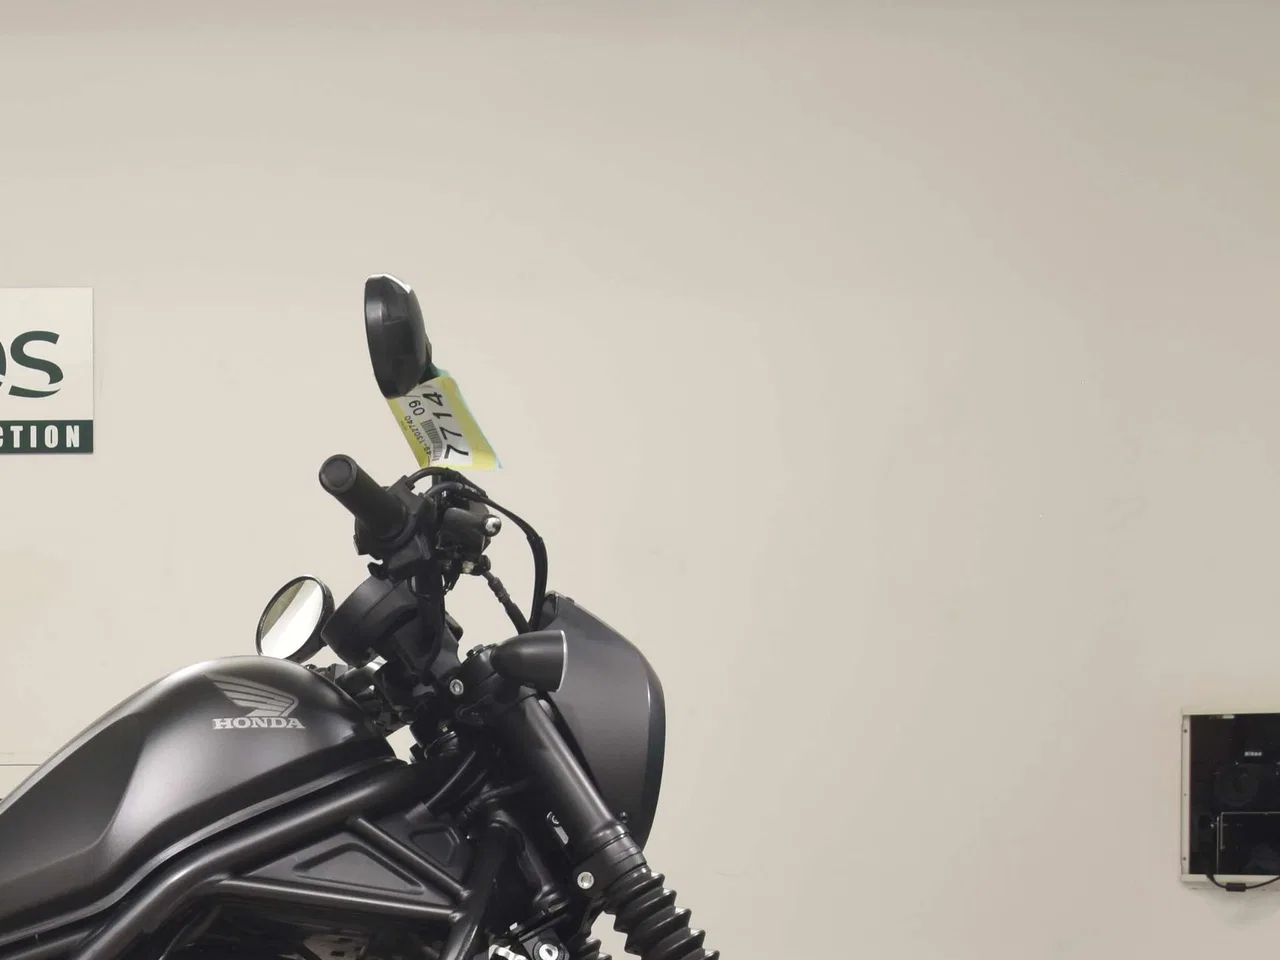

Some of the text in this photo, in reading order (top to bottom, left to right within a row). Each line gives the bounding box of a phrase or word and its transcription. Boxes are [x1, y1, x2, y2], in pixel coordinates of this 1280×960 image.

[408, 399, 426, 417] 09
[422, 391, 469, 459] 7714
[211, 717, 306, 730] HONDA
